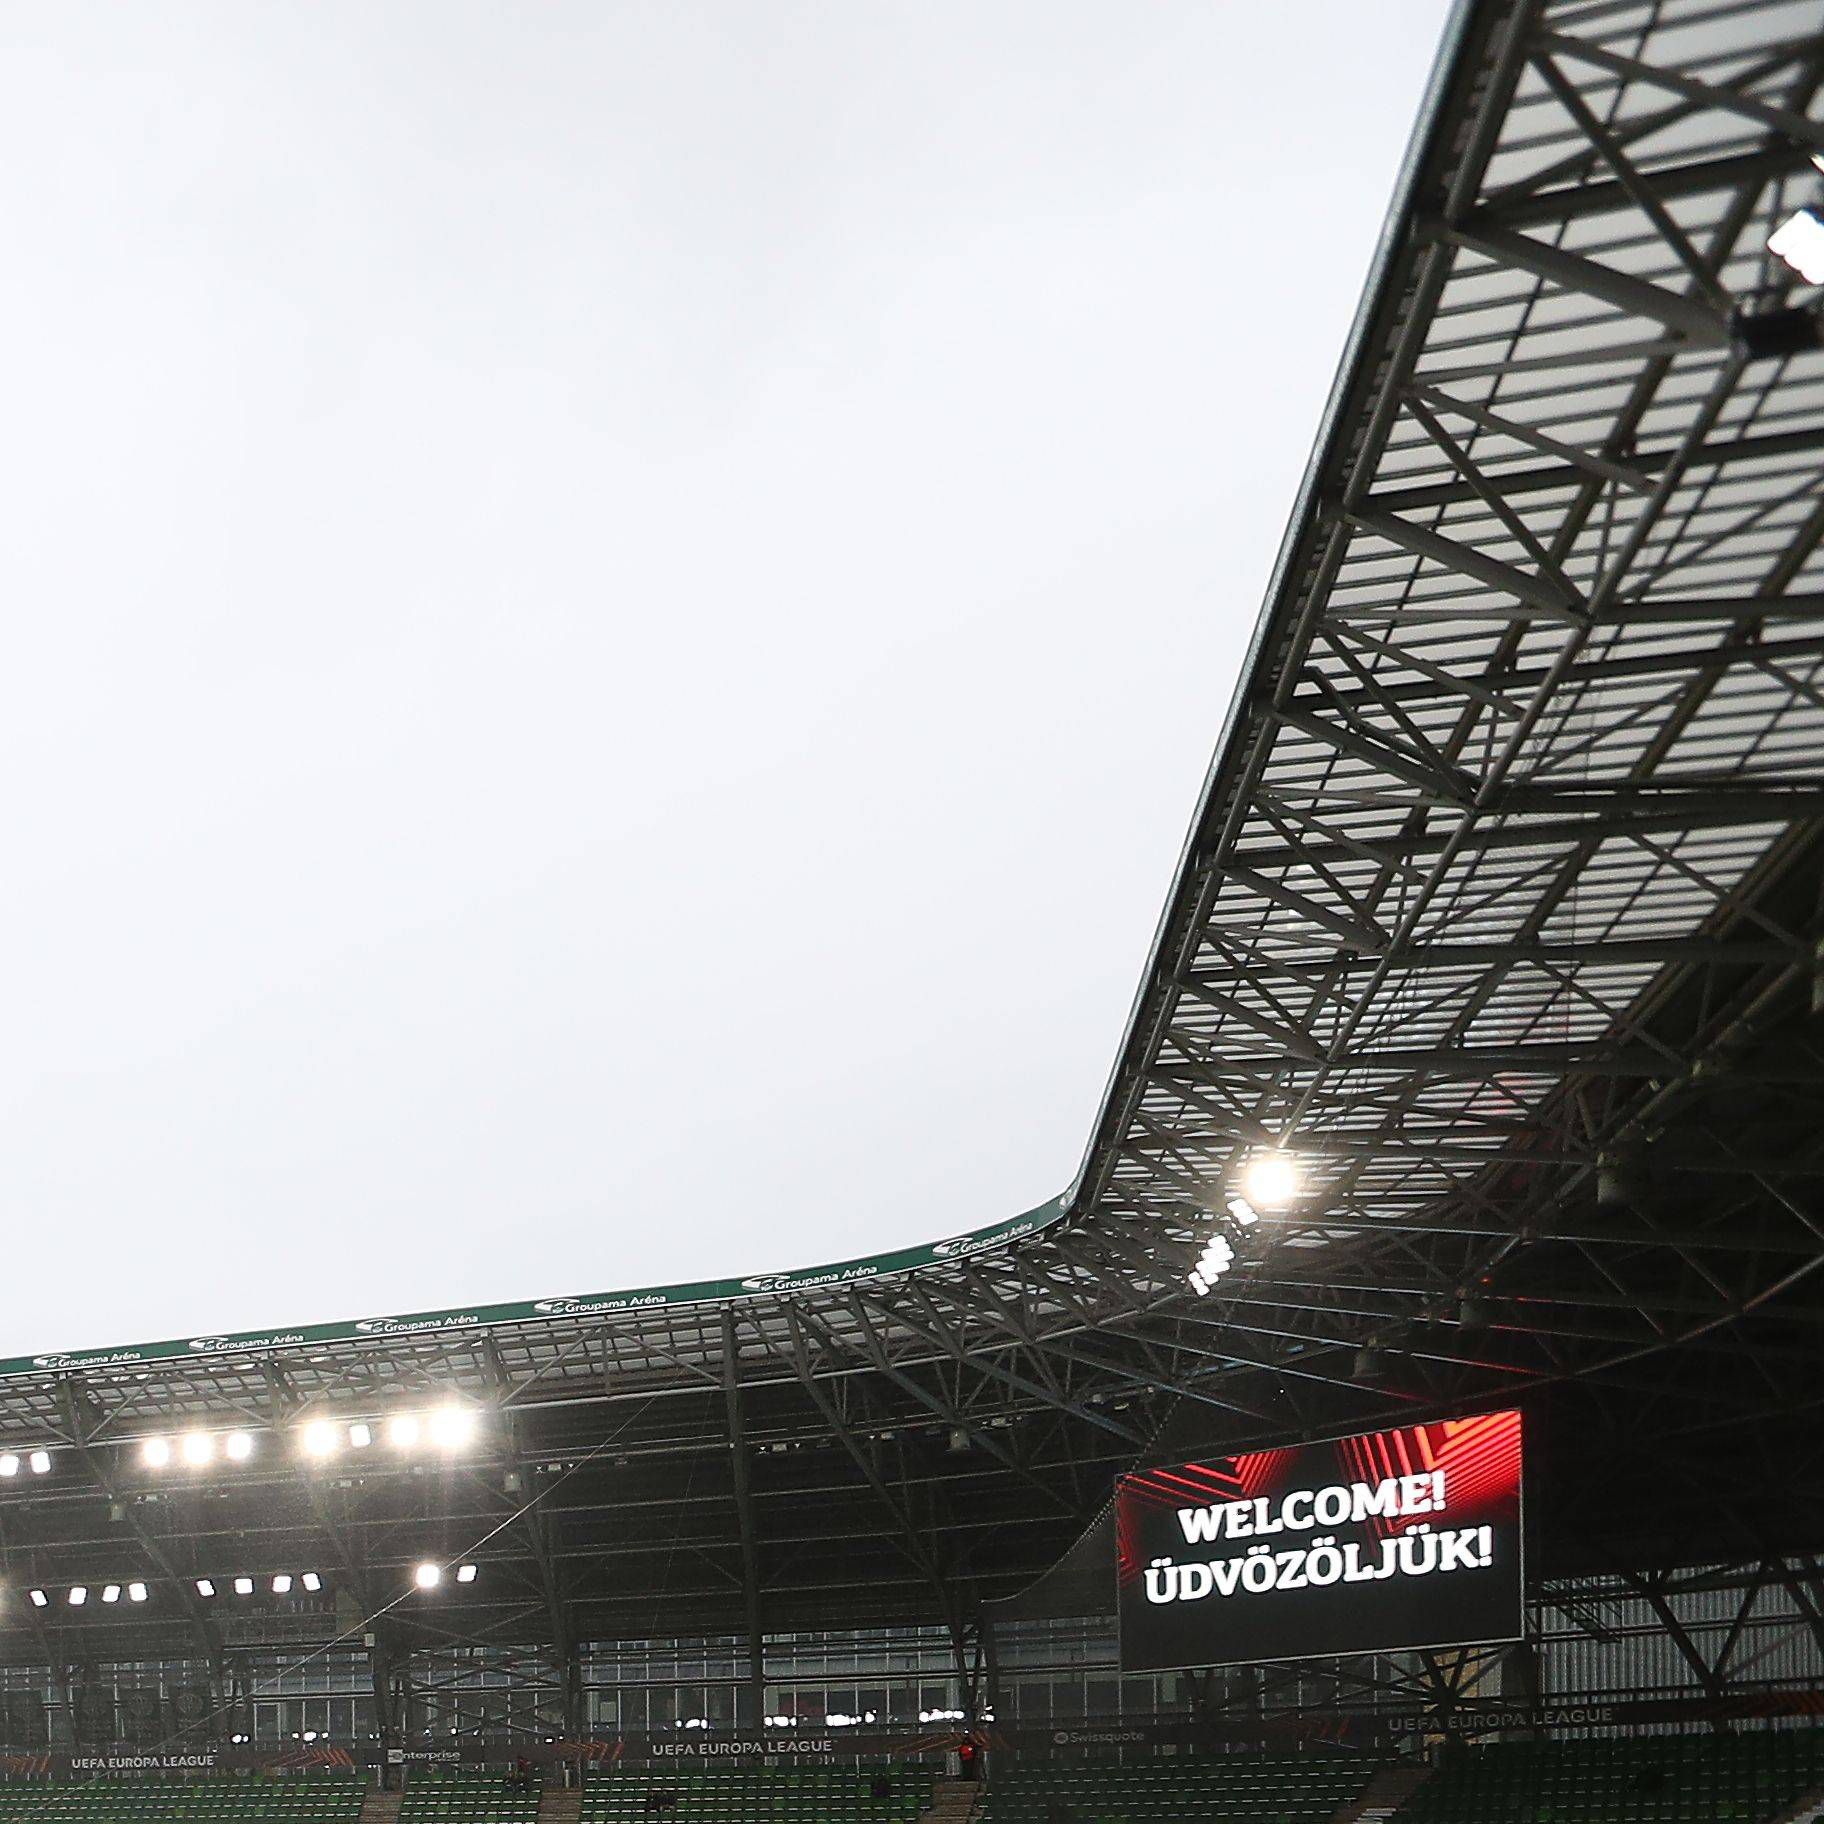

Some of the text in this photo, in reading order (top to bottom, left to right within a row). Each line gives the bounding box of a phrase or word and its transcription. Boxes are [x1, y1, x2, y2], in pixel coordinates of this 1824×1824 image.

[775, 1265, 877, 1290] Groupama Aréna
[565, 1294, 666, 1315] Groupama Aréna
[385, 1314, 478, 1334] Groupama Aréna
[216, 1333, 304, 1352] Groupama Aréna
[59, 1351, 140, 1368] Groupama Aréna
[1177, 1470, 1446, 1544] WELCOME!
[1144, 1523, 1493, 1603] ÜDVÖZÖLJÜK!
[1388, 1709, 1612, 1730] UEFA EUROPA LEAGUE
[652, 1740, 833, 1756] UEFA EUROPA LEAGUE
[72, 1756, 214, 1768] UEFA EUROPA LEAGUE
